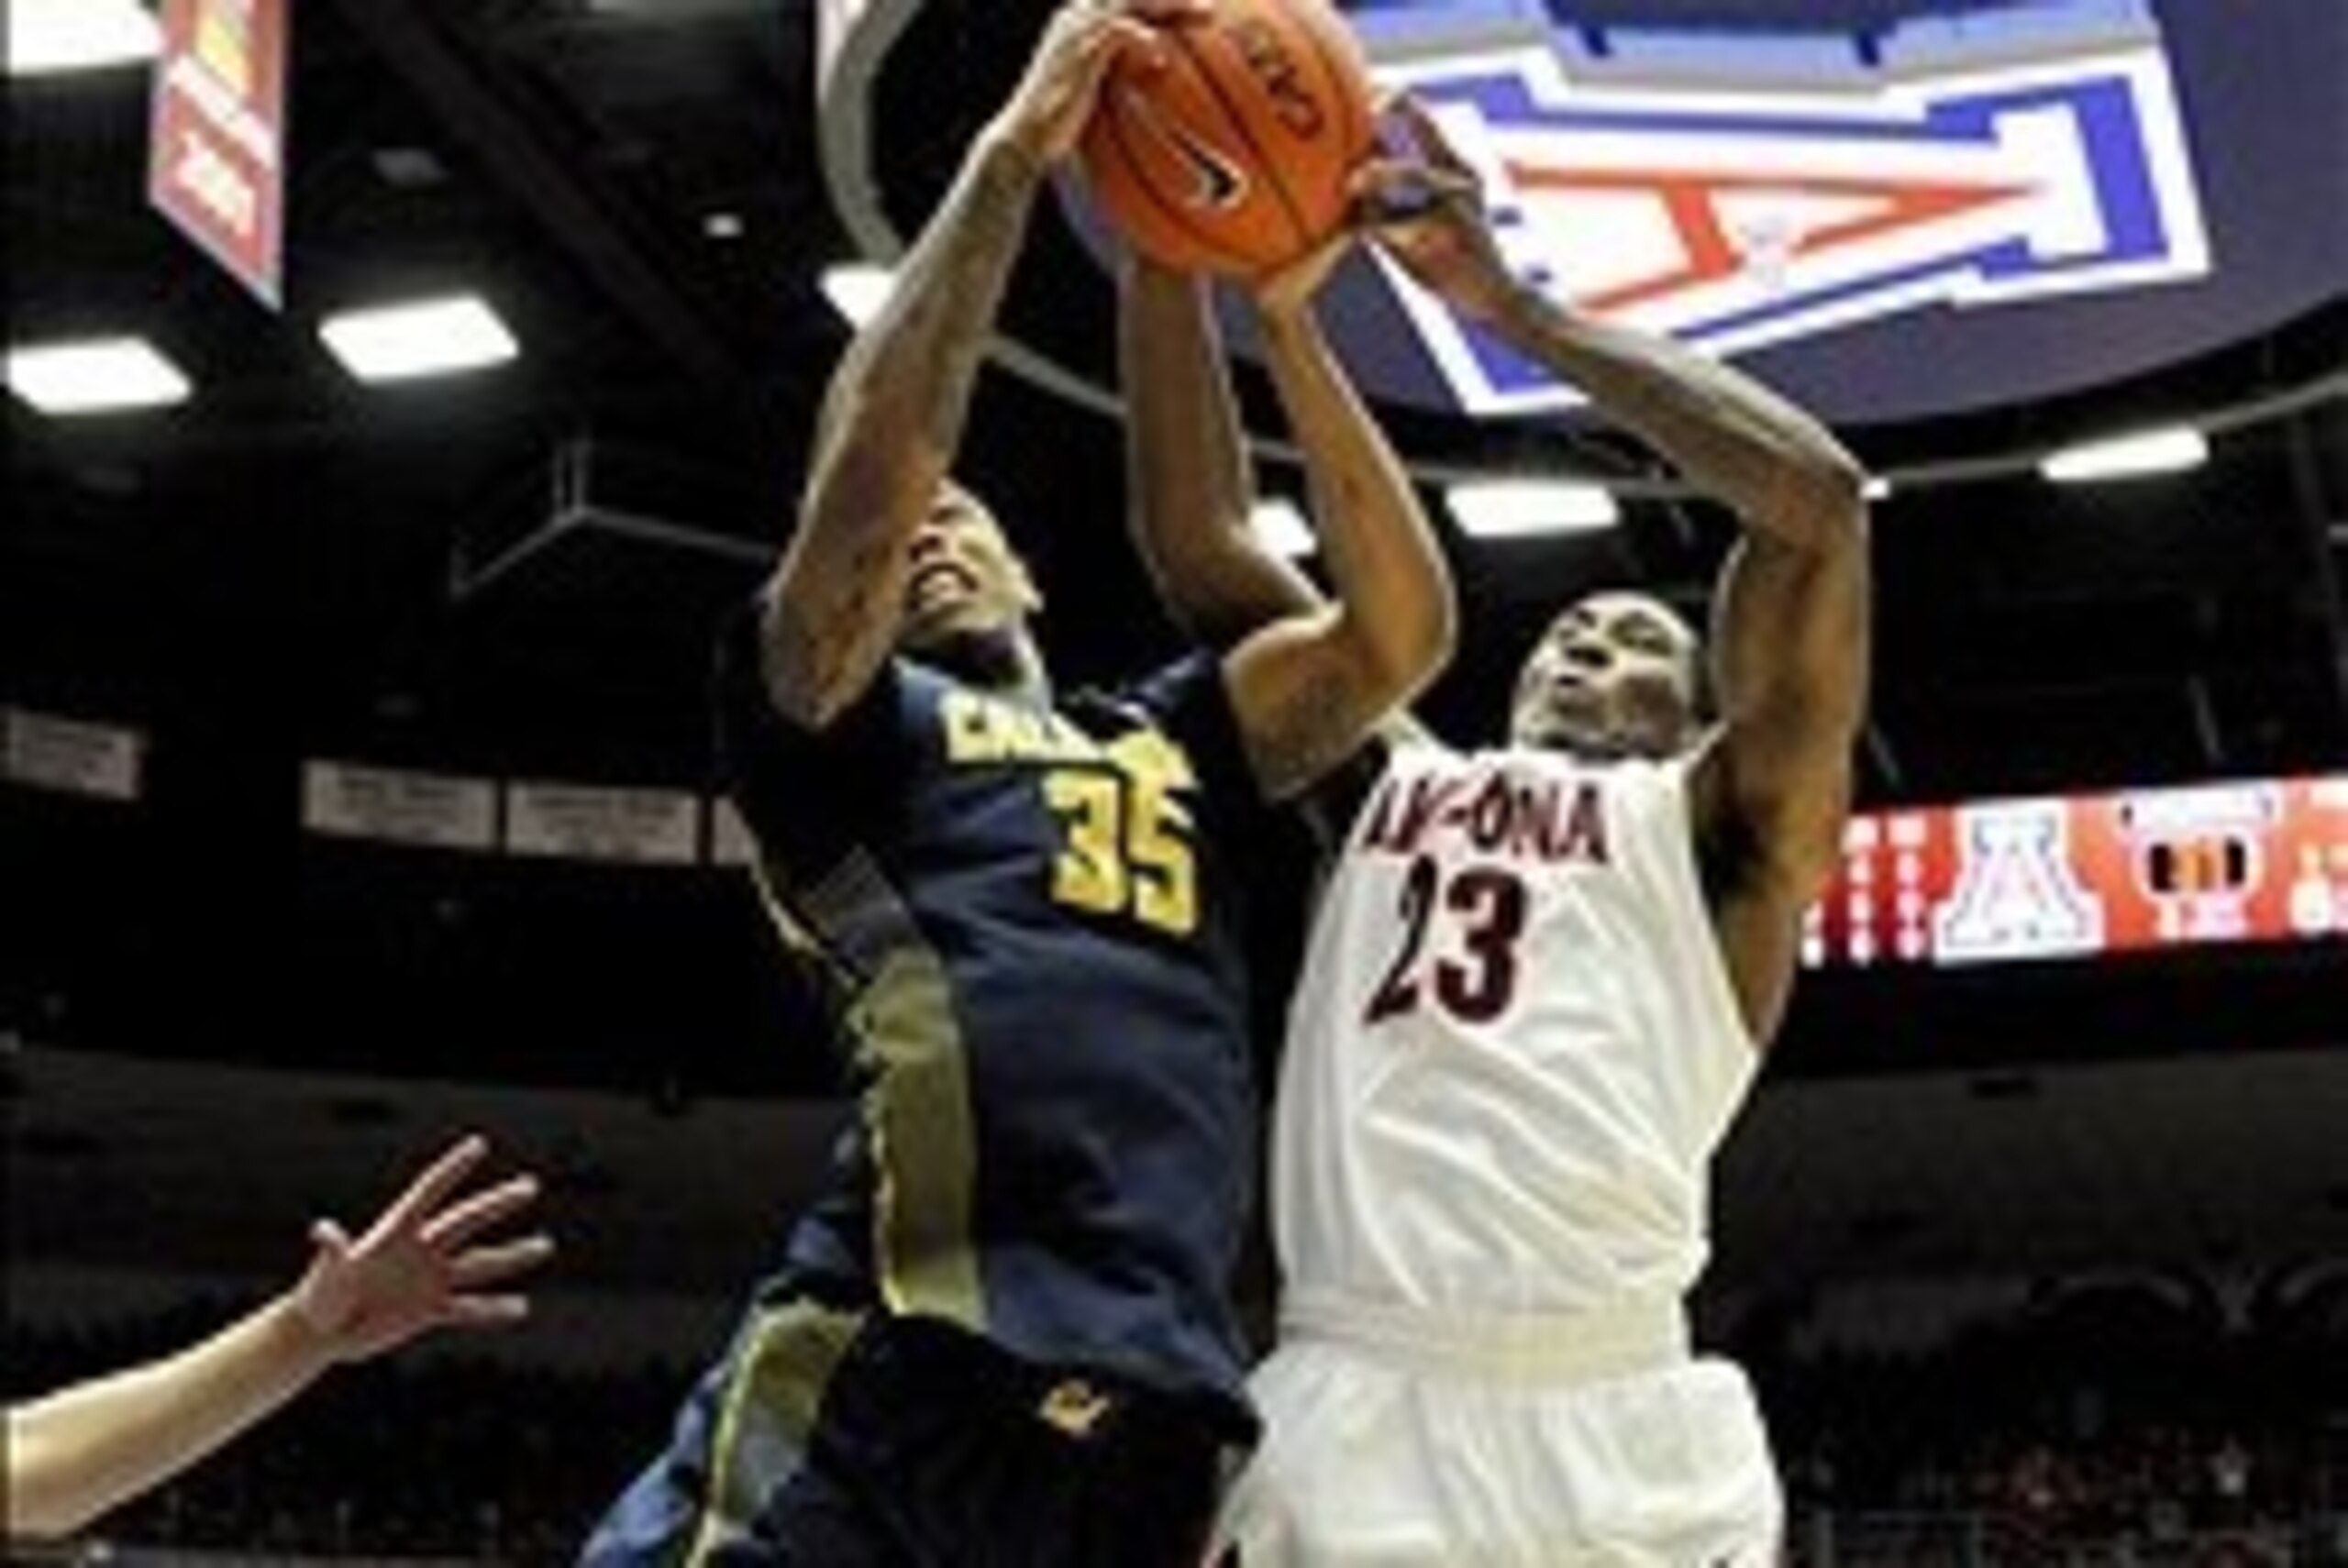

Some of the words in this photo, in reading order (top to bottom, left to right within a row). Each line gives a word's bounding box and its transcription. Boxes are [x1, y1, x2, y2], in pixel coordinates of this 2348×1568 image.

[1044, 768, 1198, 937] 35
[1933, 796, 2105, 967] A
[1361, 853, 1530, 1025] 23
